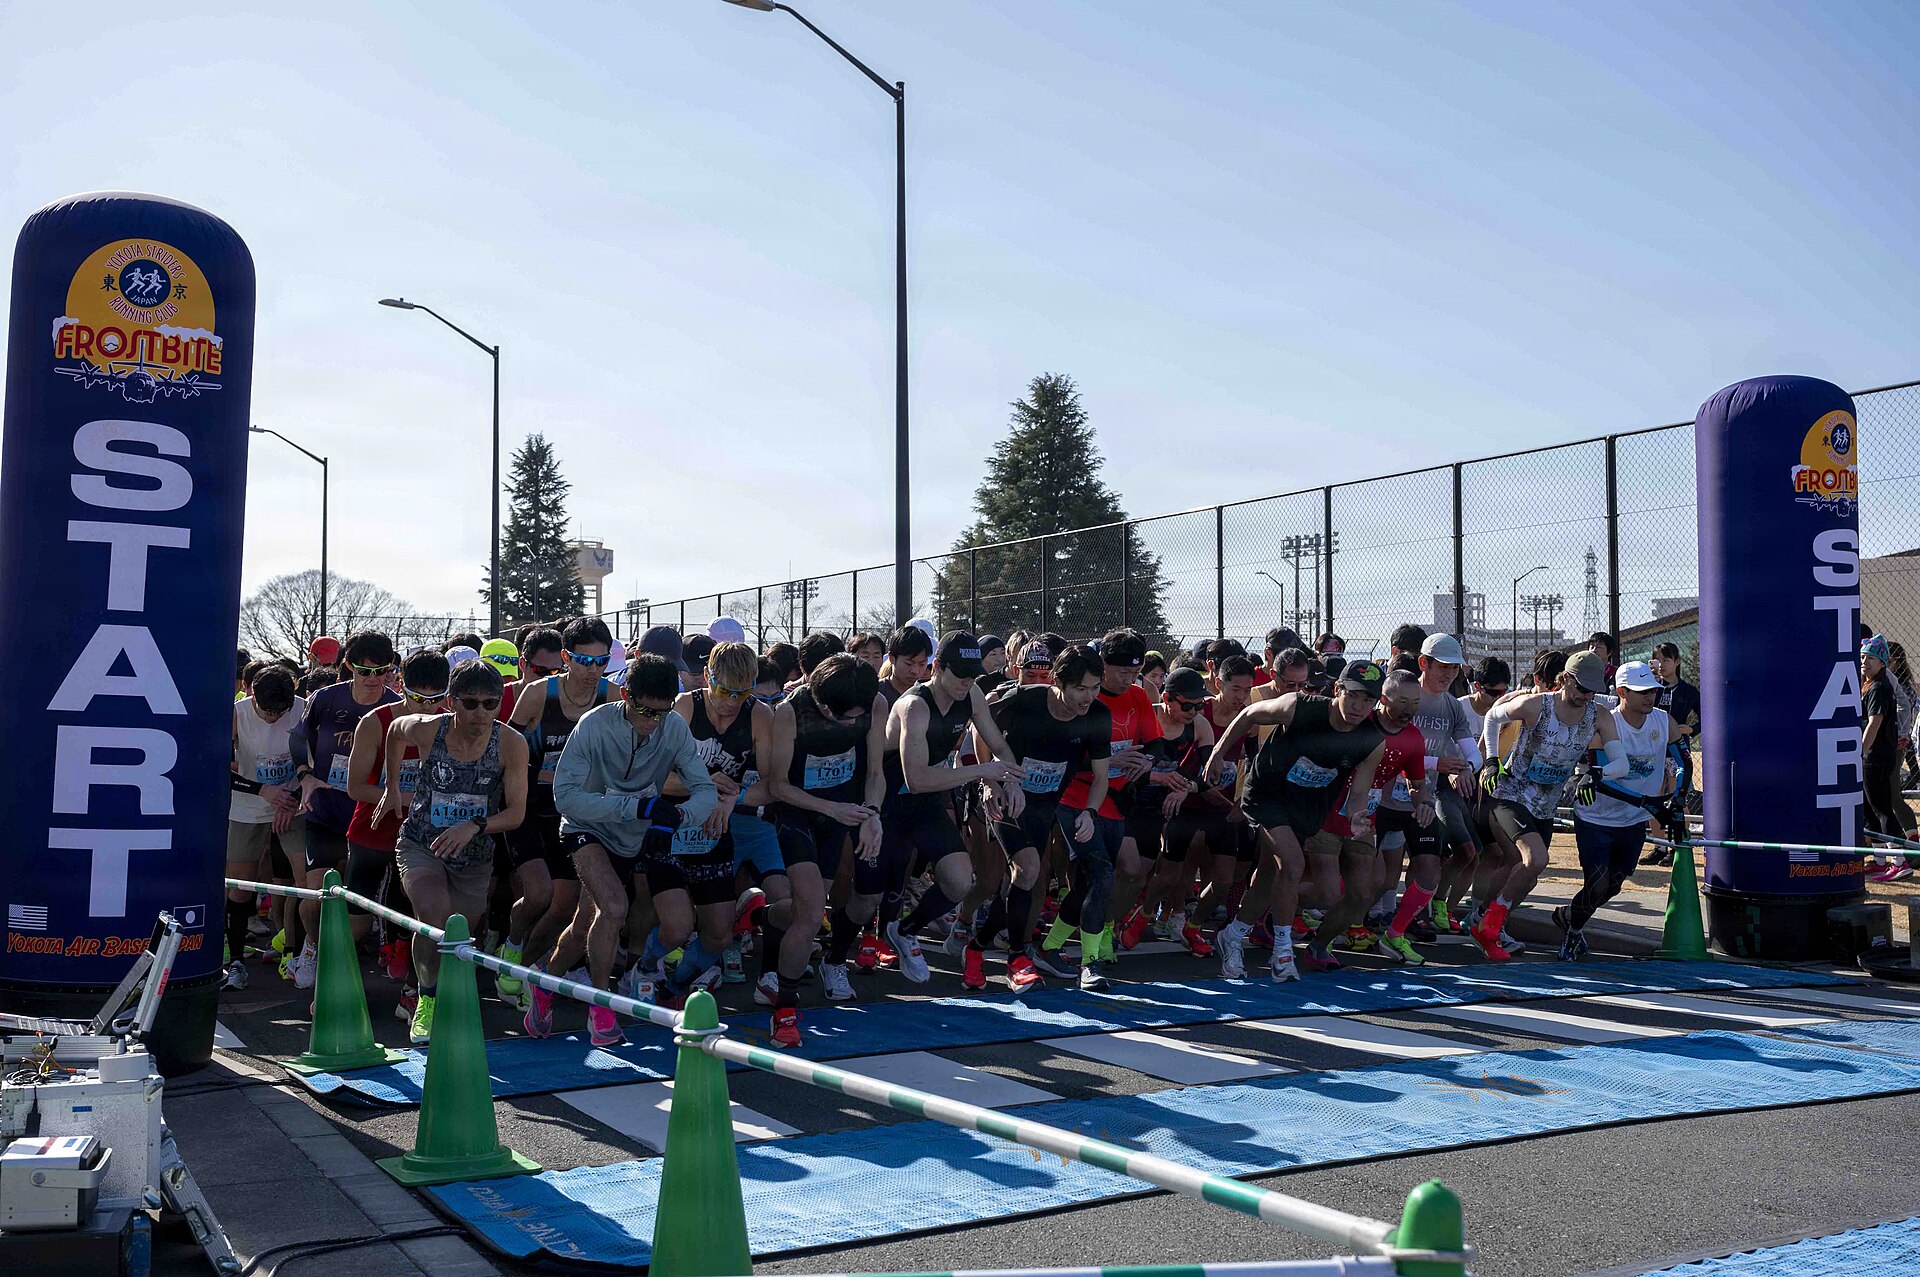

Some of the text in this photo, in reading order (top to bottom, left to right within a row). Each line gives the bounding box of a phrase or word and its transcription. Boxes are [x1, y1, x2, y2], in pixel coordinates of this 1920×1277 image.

[105, 243, 186, 279] YOKOTA STRIDERS
[100, 273, 118, 292] 東
[172, 283, 188, 300] 京
[108, 296, 180, 325] RUNNING CLUB
[130, 294, 158, 305] JAPAN
[55, 324, 222, 375] FROSTBITE
[1795, 468, 1858, 493] FROSTB
[46, 419, 194, 918] START
[1809, 528, 1864, 849] START
[816, 762, 853, 778] 17014
[7, 932, 64, 953] YOKOTA
[65, 936, 101, 958] AIR
[178, 933, 204, 952] PAN
